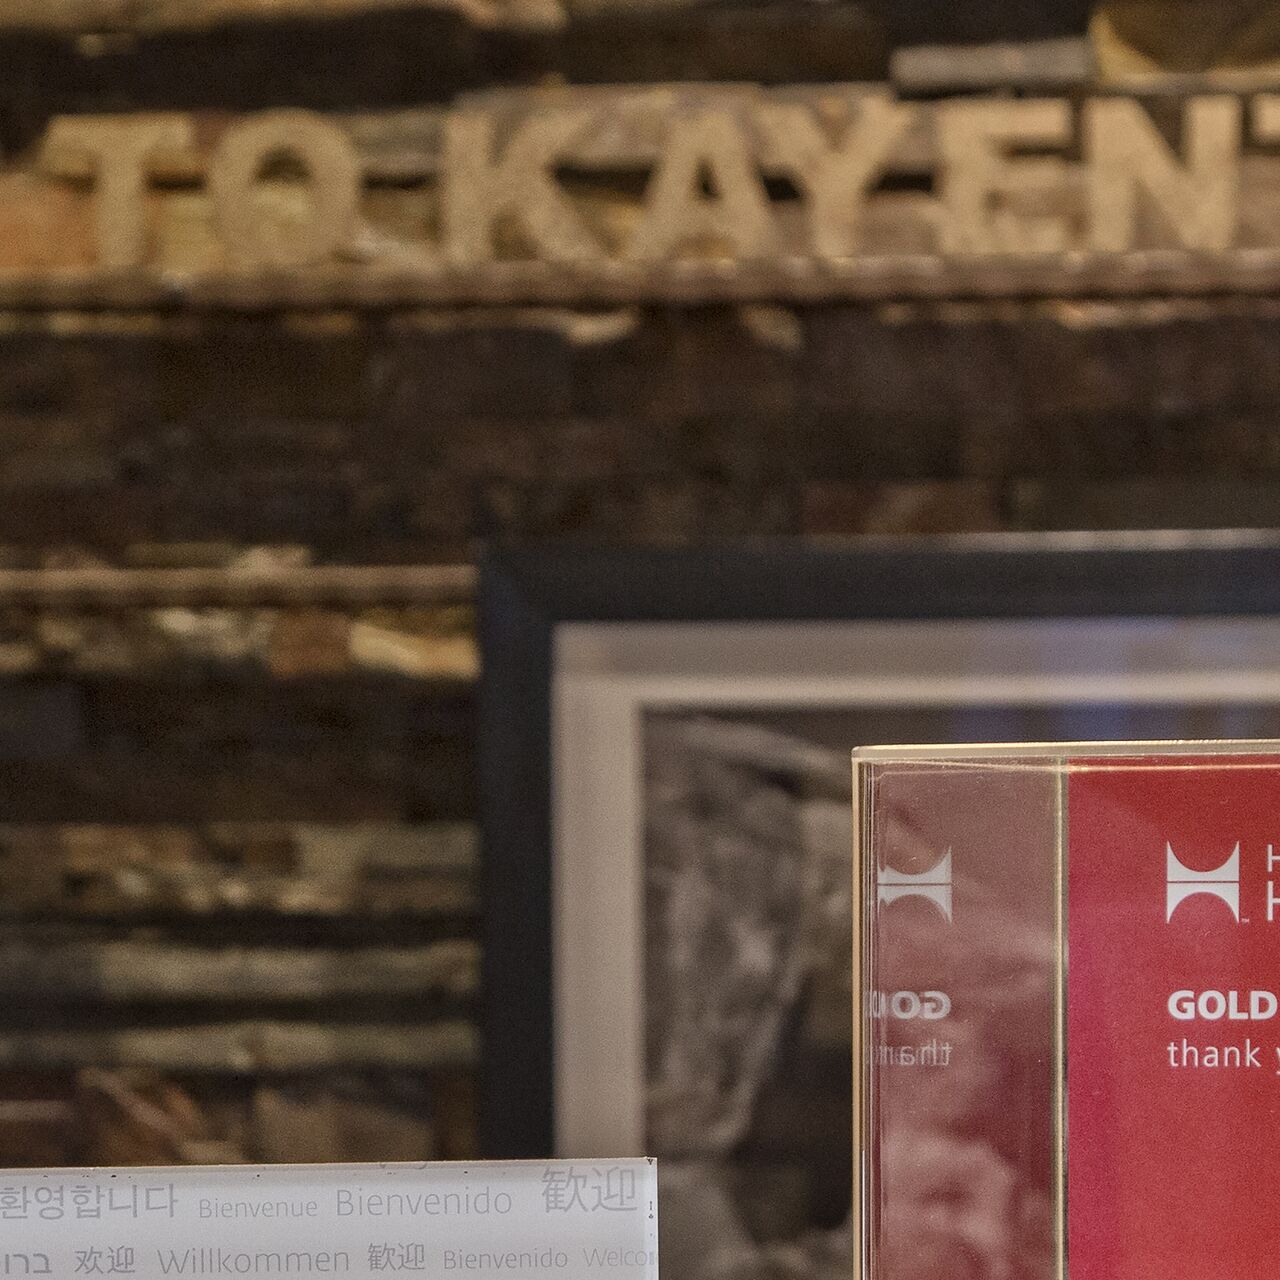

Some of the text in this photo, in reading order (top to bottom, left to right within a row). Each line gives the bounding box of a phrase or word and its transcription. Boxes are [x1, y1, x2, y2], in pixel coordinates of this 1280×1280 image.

[44, 106, 365, 272] TO
[1167, 989, 1279, 1022] GOLD
[1166, 1038, 1262, 1069] thank
[335, 1180, 513, 1217] Bienvenido
[73, 1244, 136, 1276] 欢迎
[156, 1246, 351, 1275] Willkommen
